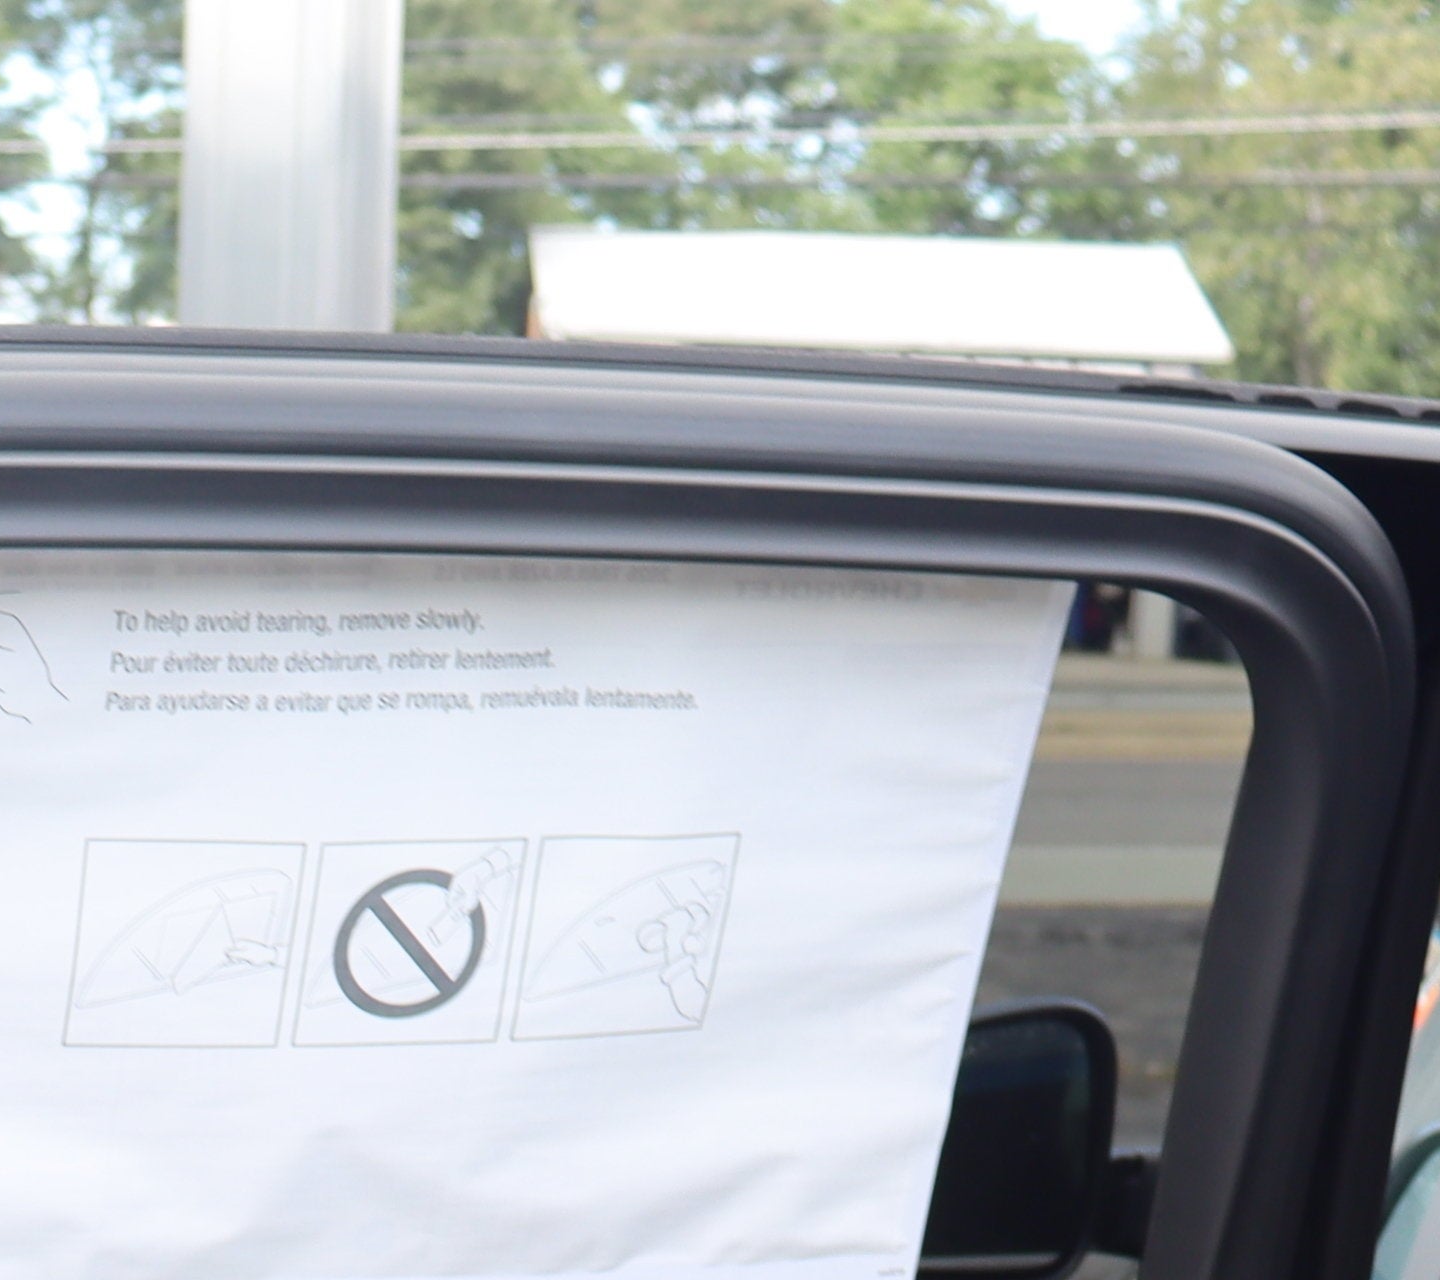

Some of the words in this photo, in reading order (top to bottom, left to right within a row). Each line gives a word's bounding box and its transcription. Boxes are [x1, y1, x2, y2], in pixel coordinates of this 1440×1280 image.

[113, 609, 138, 633] To
[144, 610, 189, 637] help
[195, 610, 250, 633] avoid
[256, 609, 332, 637] tearing,
[338, 611, 410, 632] remove
[416, 608, 485, 635] slowly.
[109, 650, 158, 673] Pour
[163, 650, 220, 673] éviter
[227, 650, 279, 673] toute
[388, 649, 450, 671] retirer
[454, 646, 556, 671] lentement.
[105, 690, 152, 712] Para
[157, 690, 250, 715] ayudarse
[255, 694, 269, 711] a
[275, 690, 332, 712] evitar
[336, 693, 373, 715] que
[377, 692, 399, 711] se
[405, 690, 475, 713] rompa,
[584, 685, 699, 711] lentamente.
